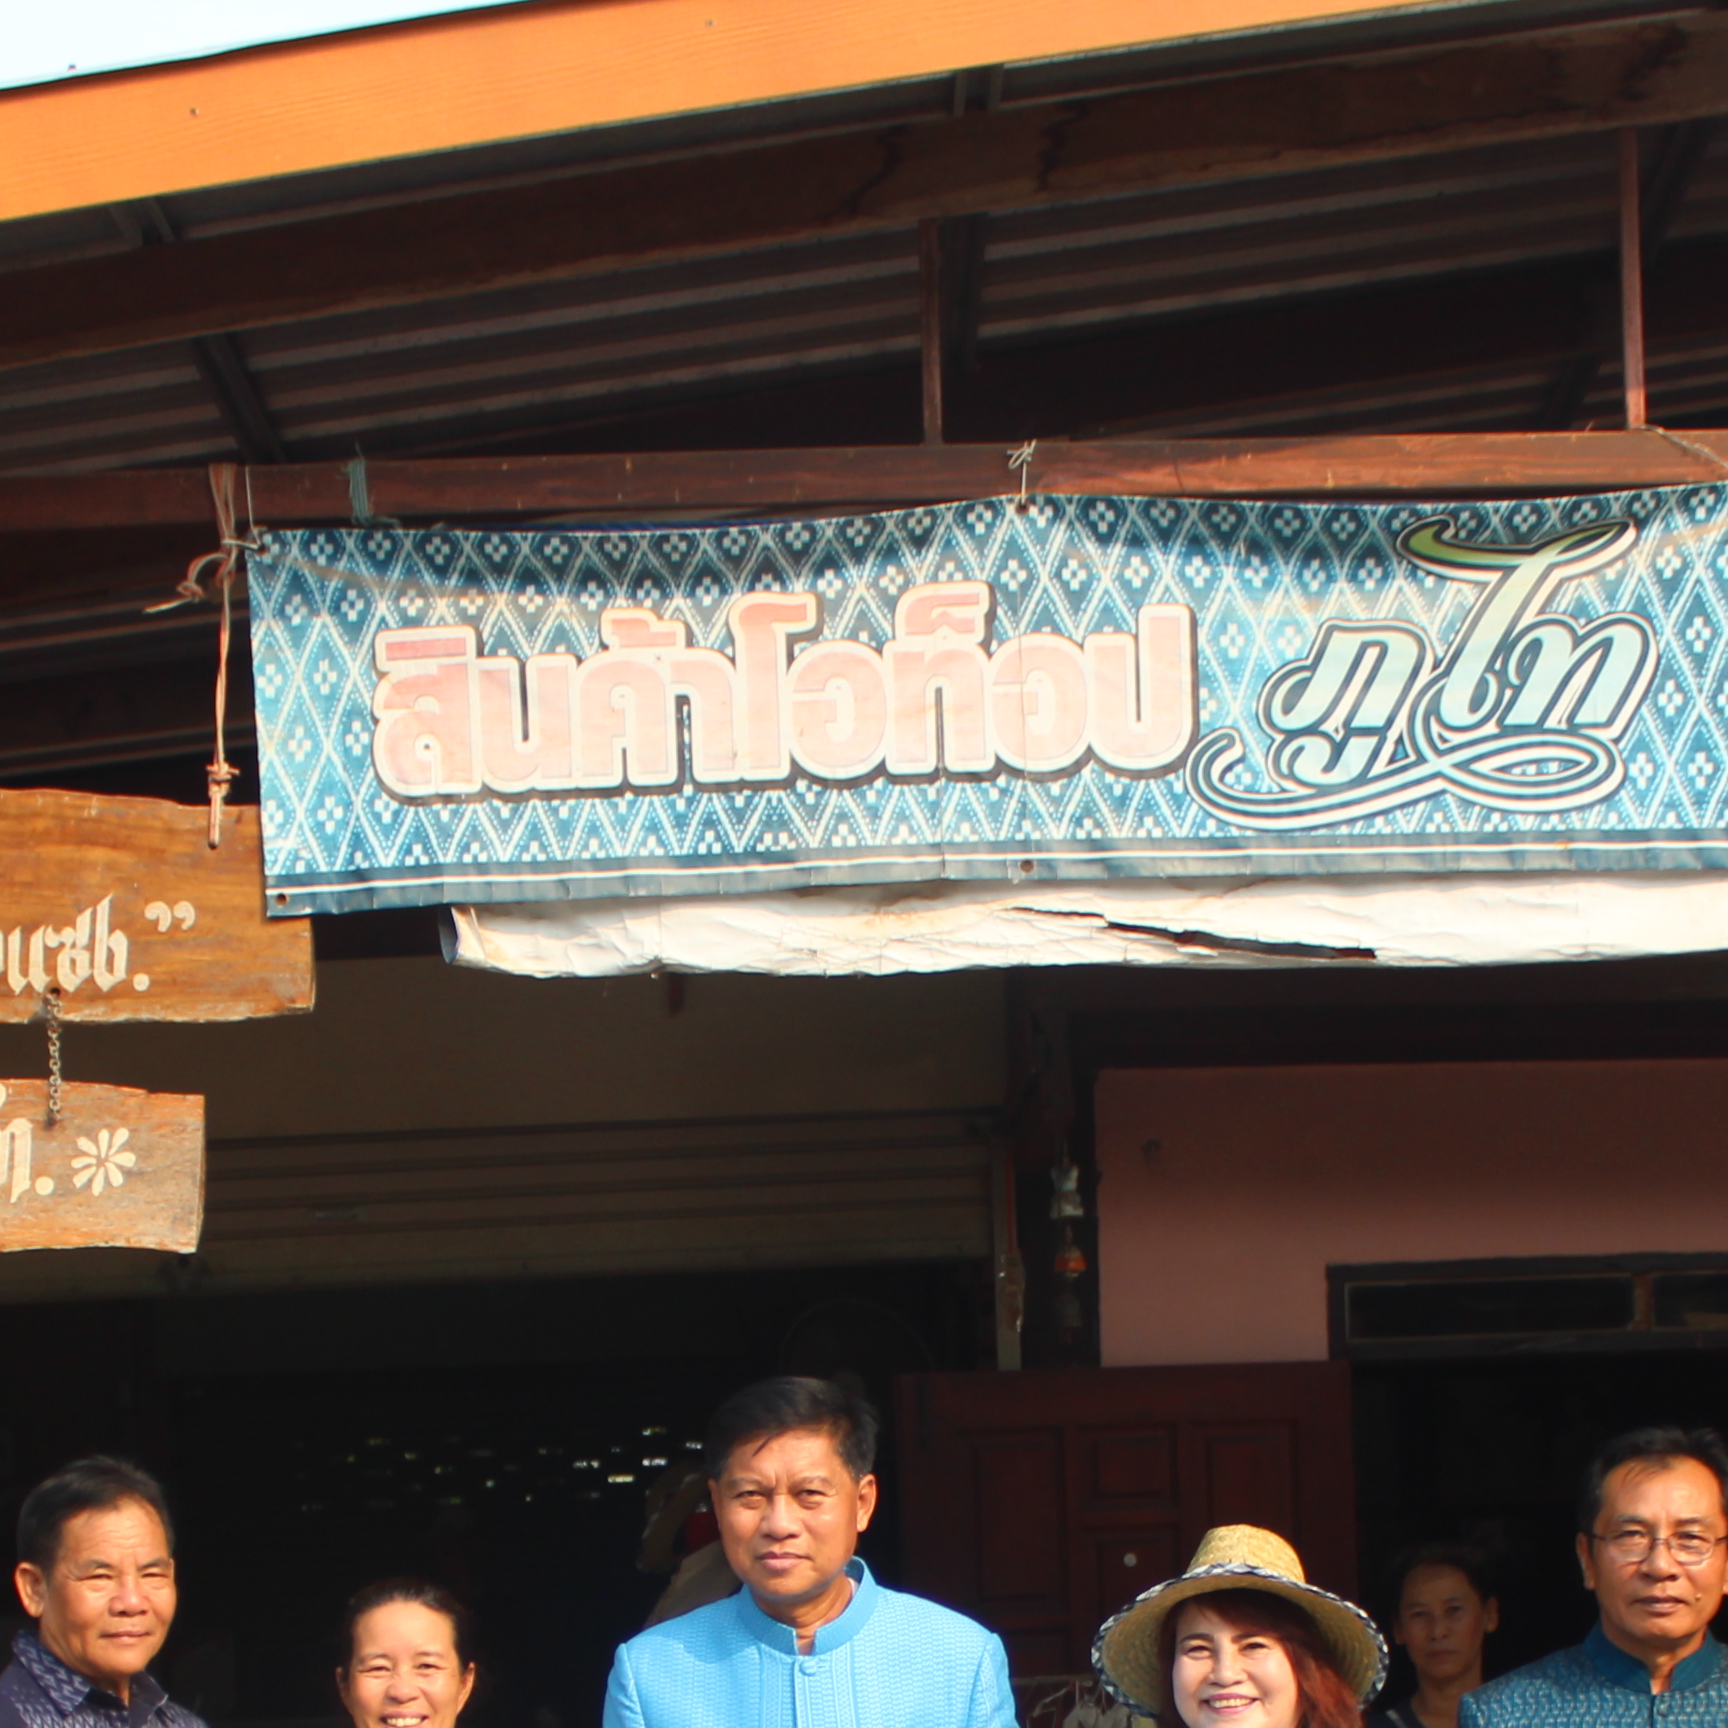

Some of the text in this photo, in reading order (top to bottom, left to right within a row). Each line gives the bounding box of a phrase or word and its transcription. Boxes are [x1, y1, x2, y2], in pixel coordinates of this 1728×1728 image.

[372, 578, 1198, 804] สินค้าโอท็อป
